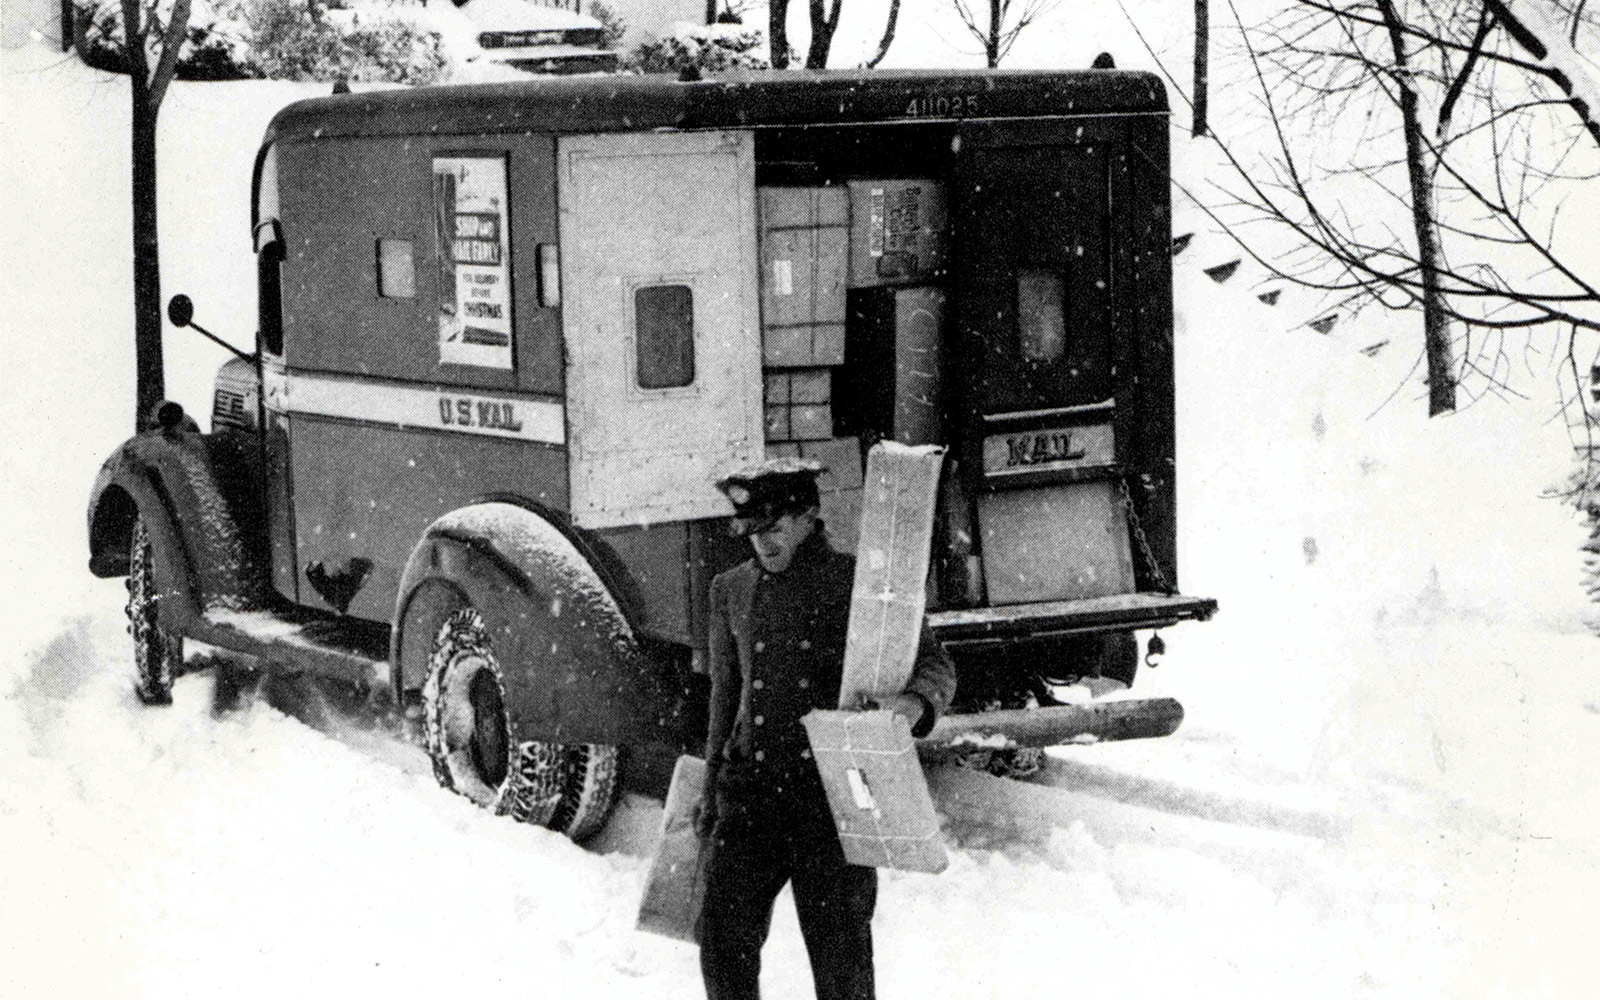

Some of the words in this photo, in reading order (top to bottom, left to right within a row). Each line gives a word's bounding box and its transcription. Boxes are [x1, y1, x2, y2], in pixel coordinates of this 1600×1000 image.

[906, 95, 979, 117] 411025
[477, 401, 523, 432] MAIL
[1006, 431, 1086, 467] MAIL
